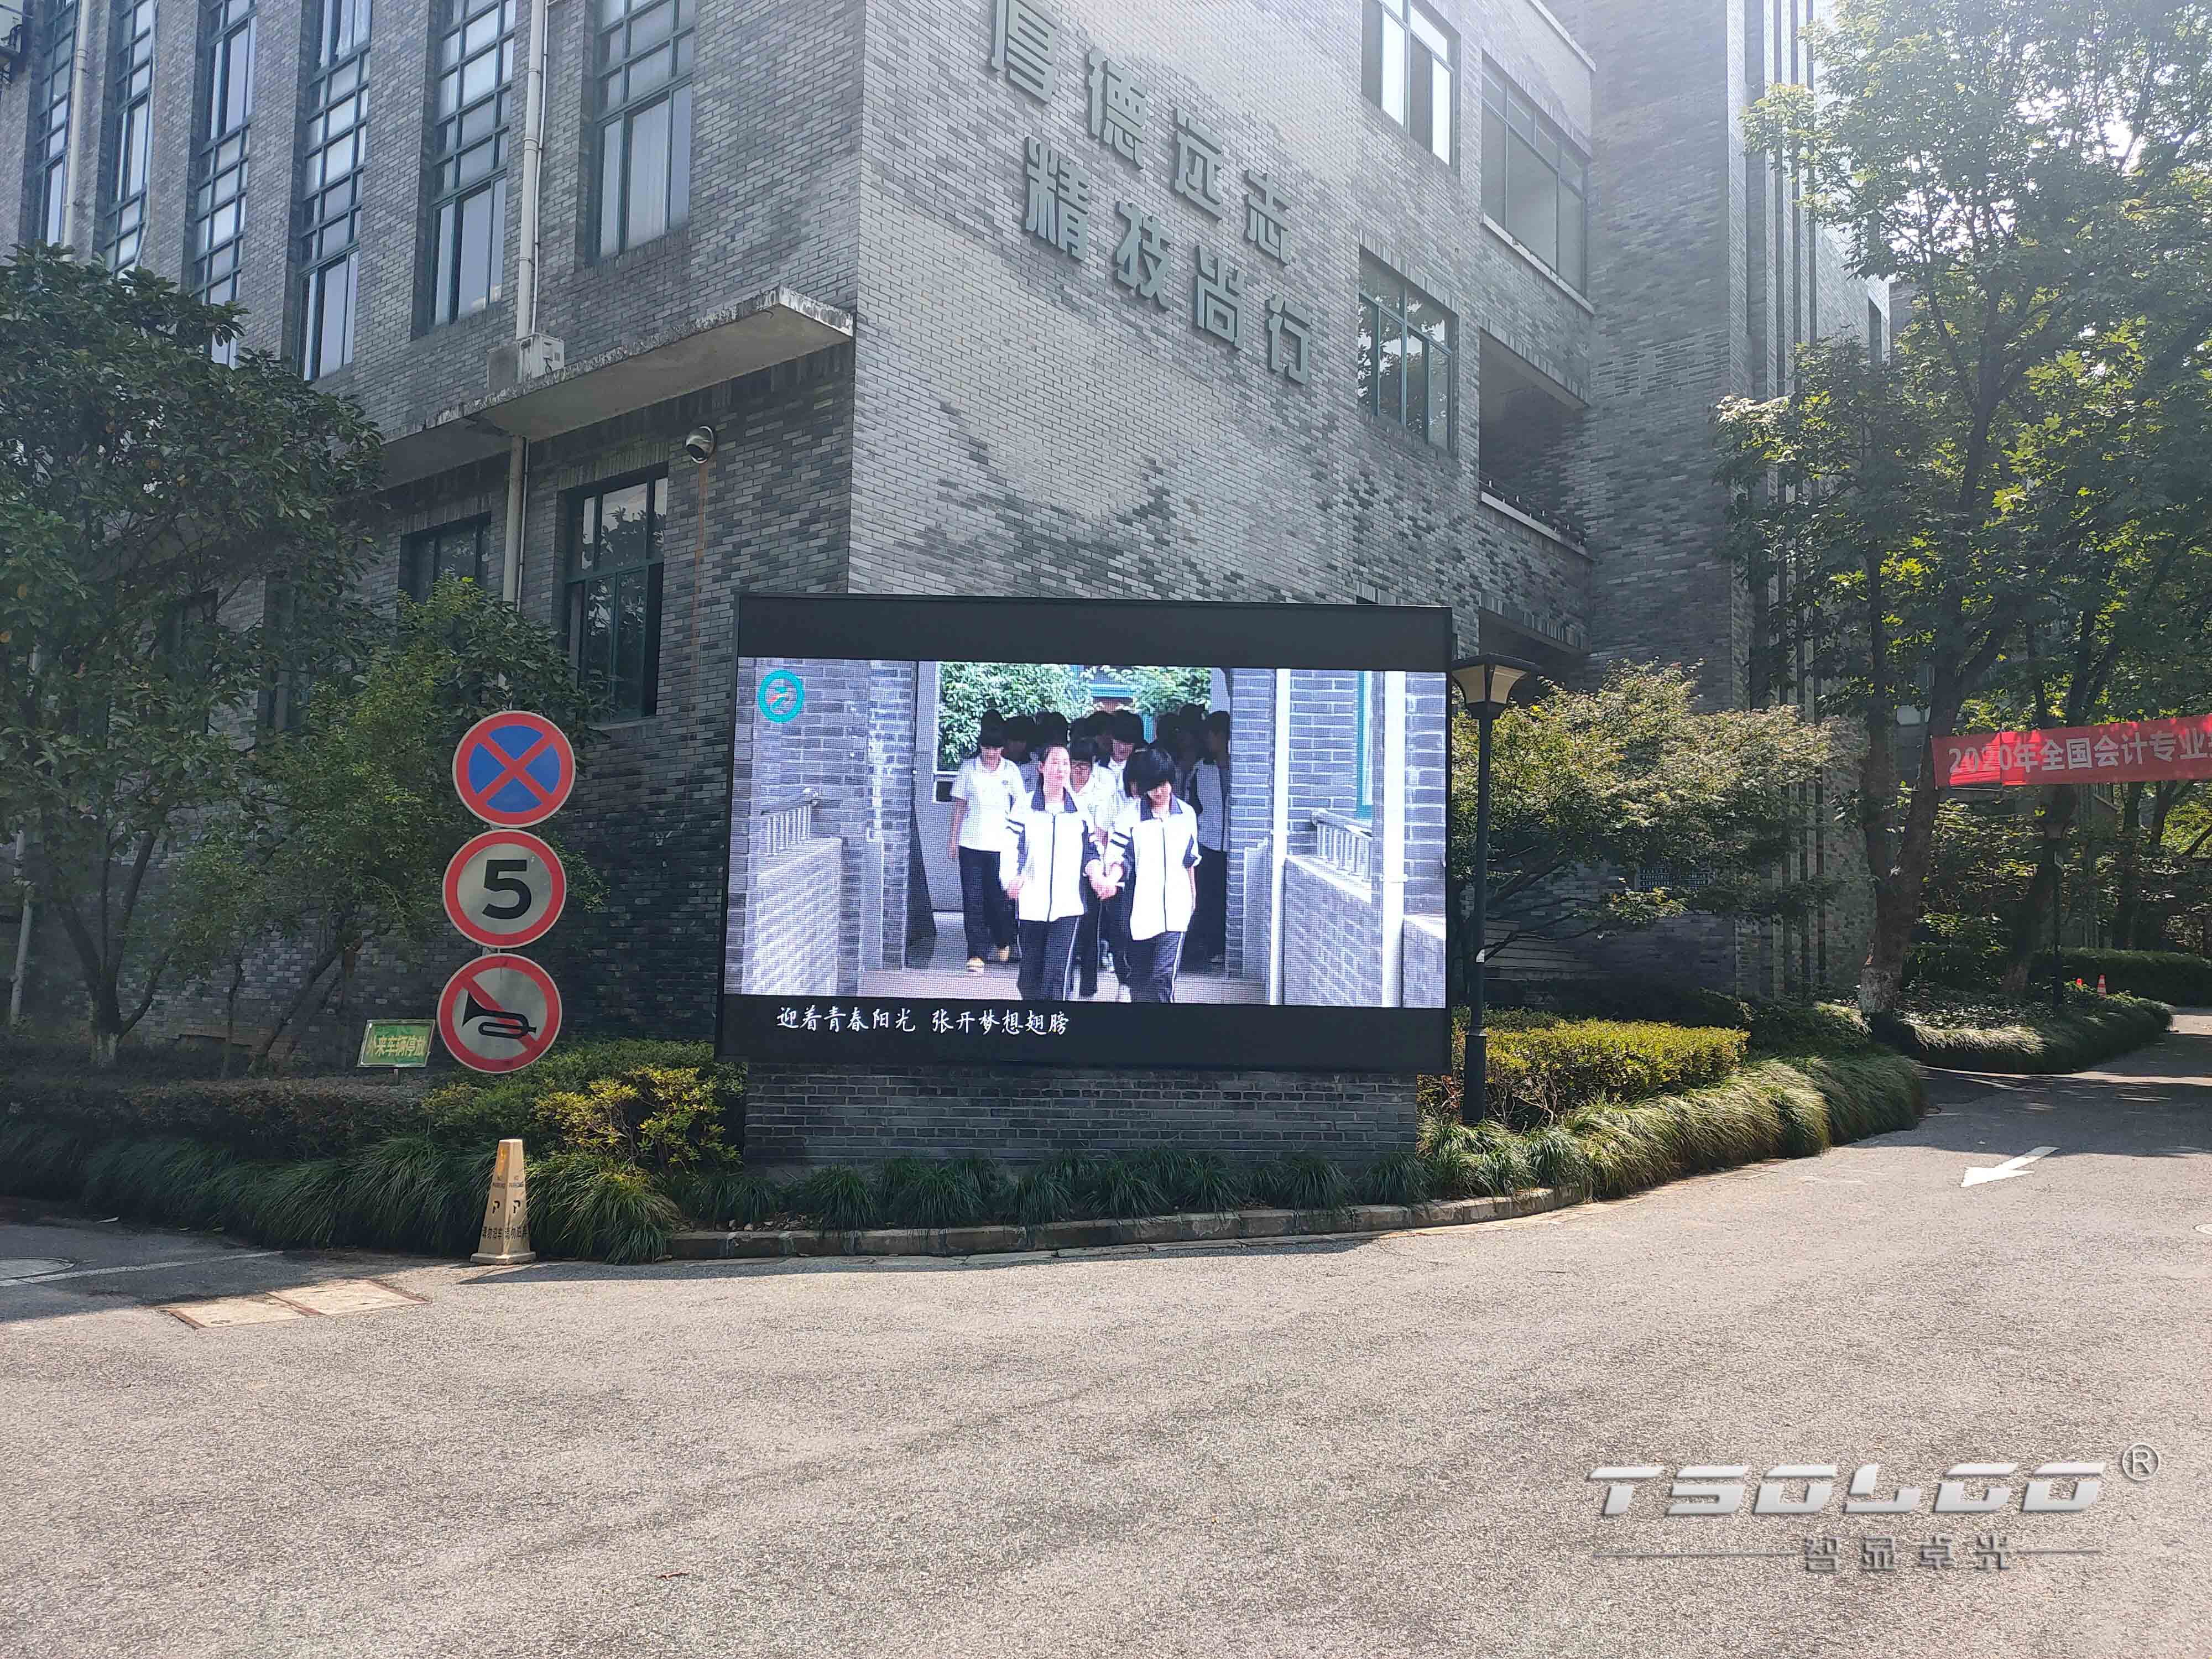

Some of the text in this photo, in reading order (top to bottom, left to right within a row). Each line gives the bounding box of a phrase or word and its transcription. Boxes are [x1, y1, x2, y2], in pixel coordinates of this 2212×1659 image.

[1025, 136, 1311, 385] 精技尚行
[1948, 728, 2212, 774] 2020年全国会计专业
[482, 859, 532, 920] 5
[776, 1004, 1070, 1035] 迎着青春阳光 张开梦想翅膀
